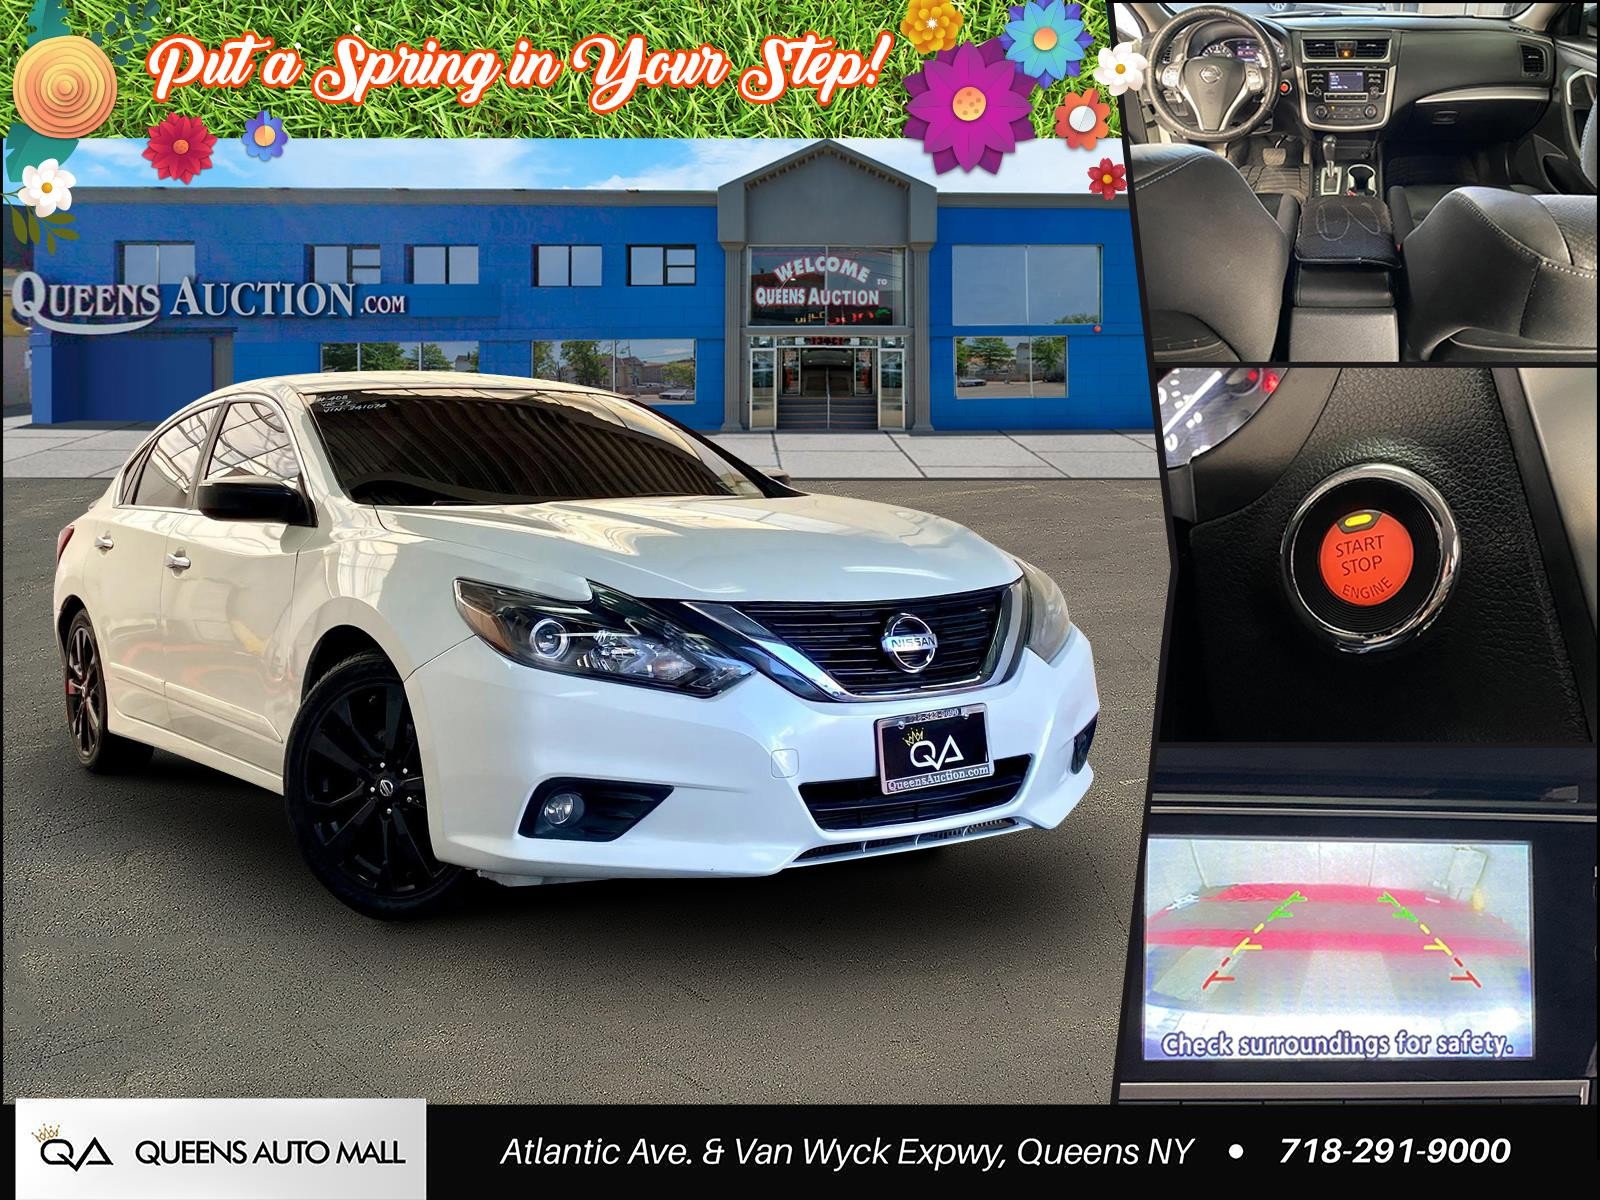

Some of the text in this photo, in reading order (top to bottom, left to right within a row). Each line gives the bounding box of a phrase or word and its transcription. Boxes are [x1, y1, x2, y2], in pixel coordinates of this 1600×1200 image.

[774, 256, 871, 283] WELCOME
[12, 271, 161, 335] QUEENS
[755, 287, 880, 306] QUEENS AUCTION
[1335, 534, 1385, 558] START
[1341, 554, 1383, 577] STOP
[1342, 576, 1393, 599] ENGINE
[890, 635, 936, 649] NISSAN
[910, 734, 965, 771] QA
[887, 765, 989, 792] QueensAuction.com
[1162, 1029, 1514, 1059] Check surroundings for safety.
